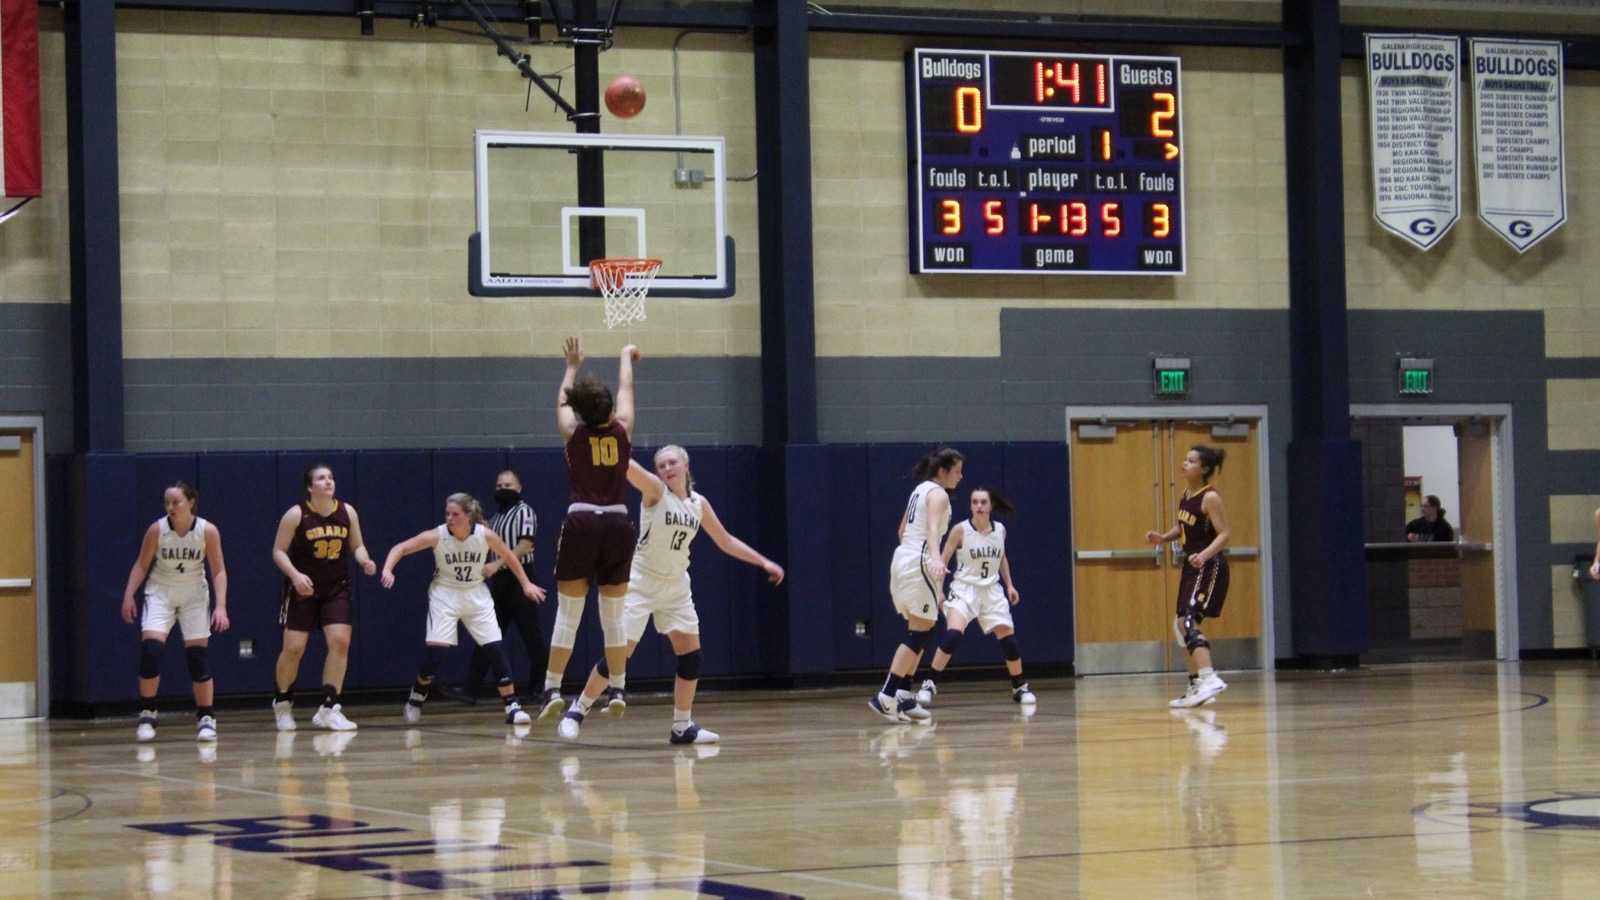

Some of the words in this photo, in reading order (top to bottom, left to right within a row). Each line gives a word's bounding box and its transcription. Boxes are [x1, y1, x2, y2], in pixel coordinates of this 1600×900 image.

[922, 58, 982, 80] Bulldogs
[1372, 52, 1454, 72] BULLDOGS
[1476, 56, 1557, 76] BULLDOGS
[1035, 62, 1106, 105] 1:41
[1120, 65, 1173, 86] Guests
[1382, 76, 1400, 85] BOYS
[1400, 77, 1443, 86] BASKETBALL
[1484, 80, 1502, 89] BOYS
[1504, 81, 1546, 90] BASKETBALL
[956, 86, 982, 132] 0
[1151, 92, 1176, 138] 2
[1390, 106, 1423, 114] REGIONAL
[1029, 135, 1076, 157] period
[1102, 130, 1111, 160] 1
[1392, 132, 1424, 140] REGIONAL
[1510, 146, 1534, 154] CHAMPS
[1392, 158, 1426, 166] REGIONAL
[1526, 164, 1558, 172] RUNNER-UP
[930, 168, 966, 188] fouls
[1029, 169, 1078, 191] player
[1140, 173, 1174, 192] fouls
[942, 200, 961, 234] 3
[984, 200, 1004, 236] 5
[1101, 202, 1121, 236] 5
[1152, 204, 1170, 237] 3
[1410, 218, 1436, 236] G
[1509, 220, 1534, 238] G
[934, 246, 964, 262] won
[1036, 248, 1074, 266] game
[1144, 249, 1173, 264] won
[1161, 371, 1184, 392] EXIT
[1405, 371, 1428, 392] EXIT
[589, 436, 618, 466] 10
[314, 539, 342, 560] 32
[670, 530, 688, 550] 13
[162, 548, 201, 560] GALENA
[445, 551, 482, 564] GALENA
[970, 546, 1001, 560] GALENA
[176, 563, 184, 574] 4
[454, 566, 472, 582] 32
[981, 562, 988, 578] 5
